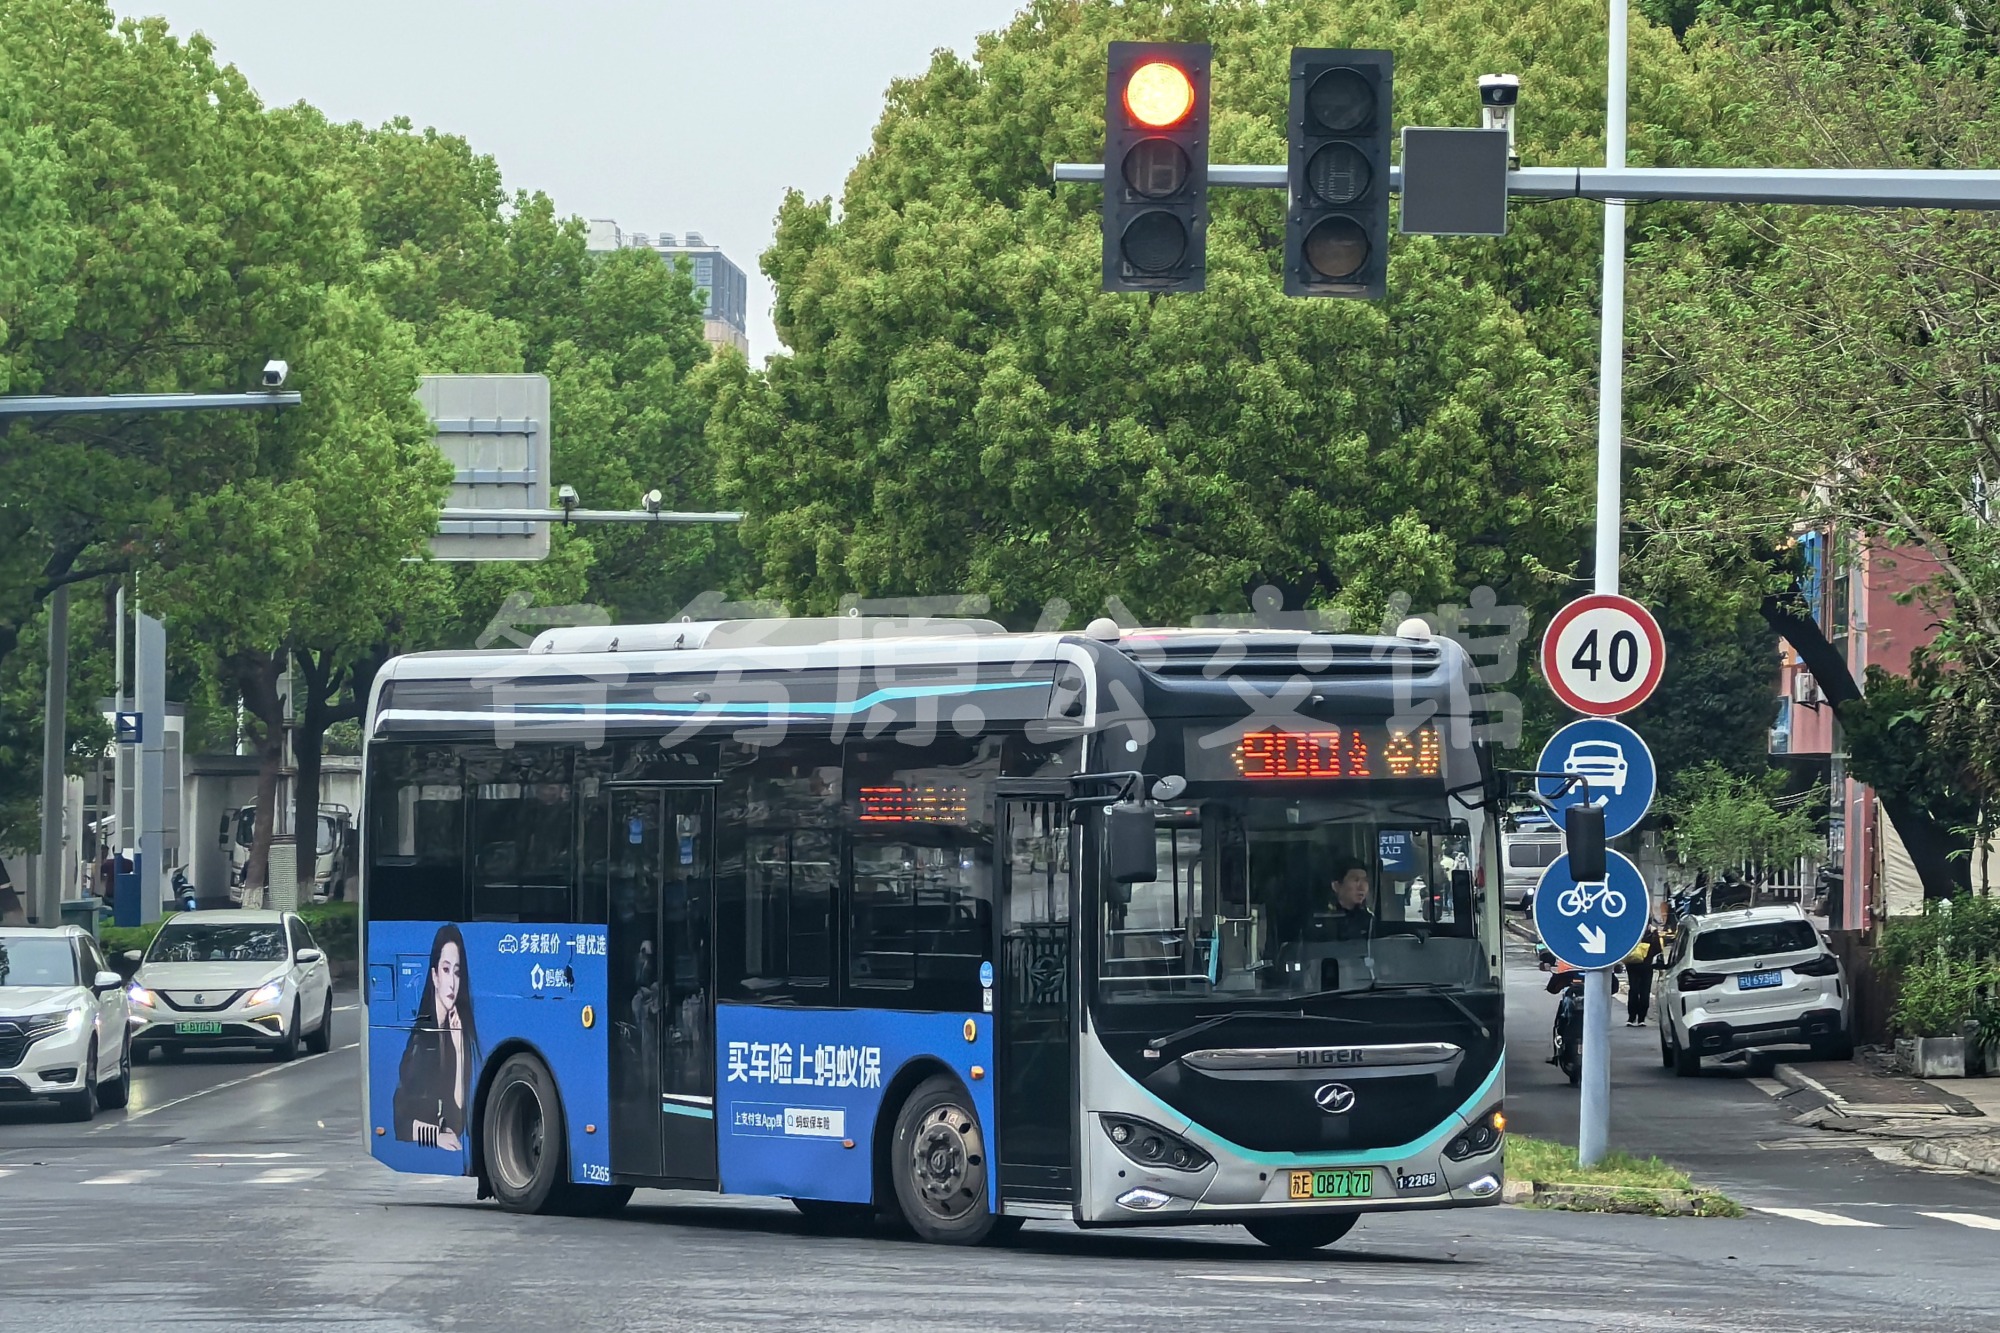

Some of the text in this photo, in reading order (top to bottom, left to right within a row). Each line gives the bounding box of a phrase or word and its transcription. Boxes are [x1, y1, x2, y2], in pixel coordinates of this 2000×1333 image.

[1572, 629, 1638, 682] 40
[520, 932, 606, 955] 多家报价 一键优选
[545, 968, 574, 988] 蚂蚁
[727, 1041, 881, 1089] 买车险上蚂蚁保
[1296, 1049, 1364, 1065] HIGER
[795, 1114, 831, 1131] 蚂蚁保车险
[582, 1163, 610, 1182] 1-2265
[1397, 1173, 1436, 1190] 1-2265
